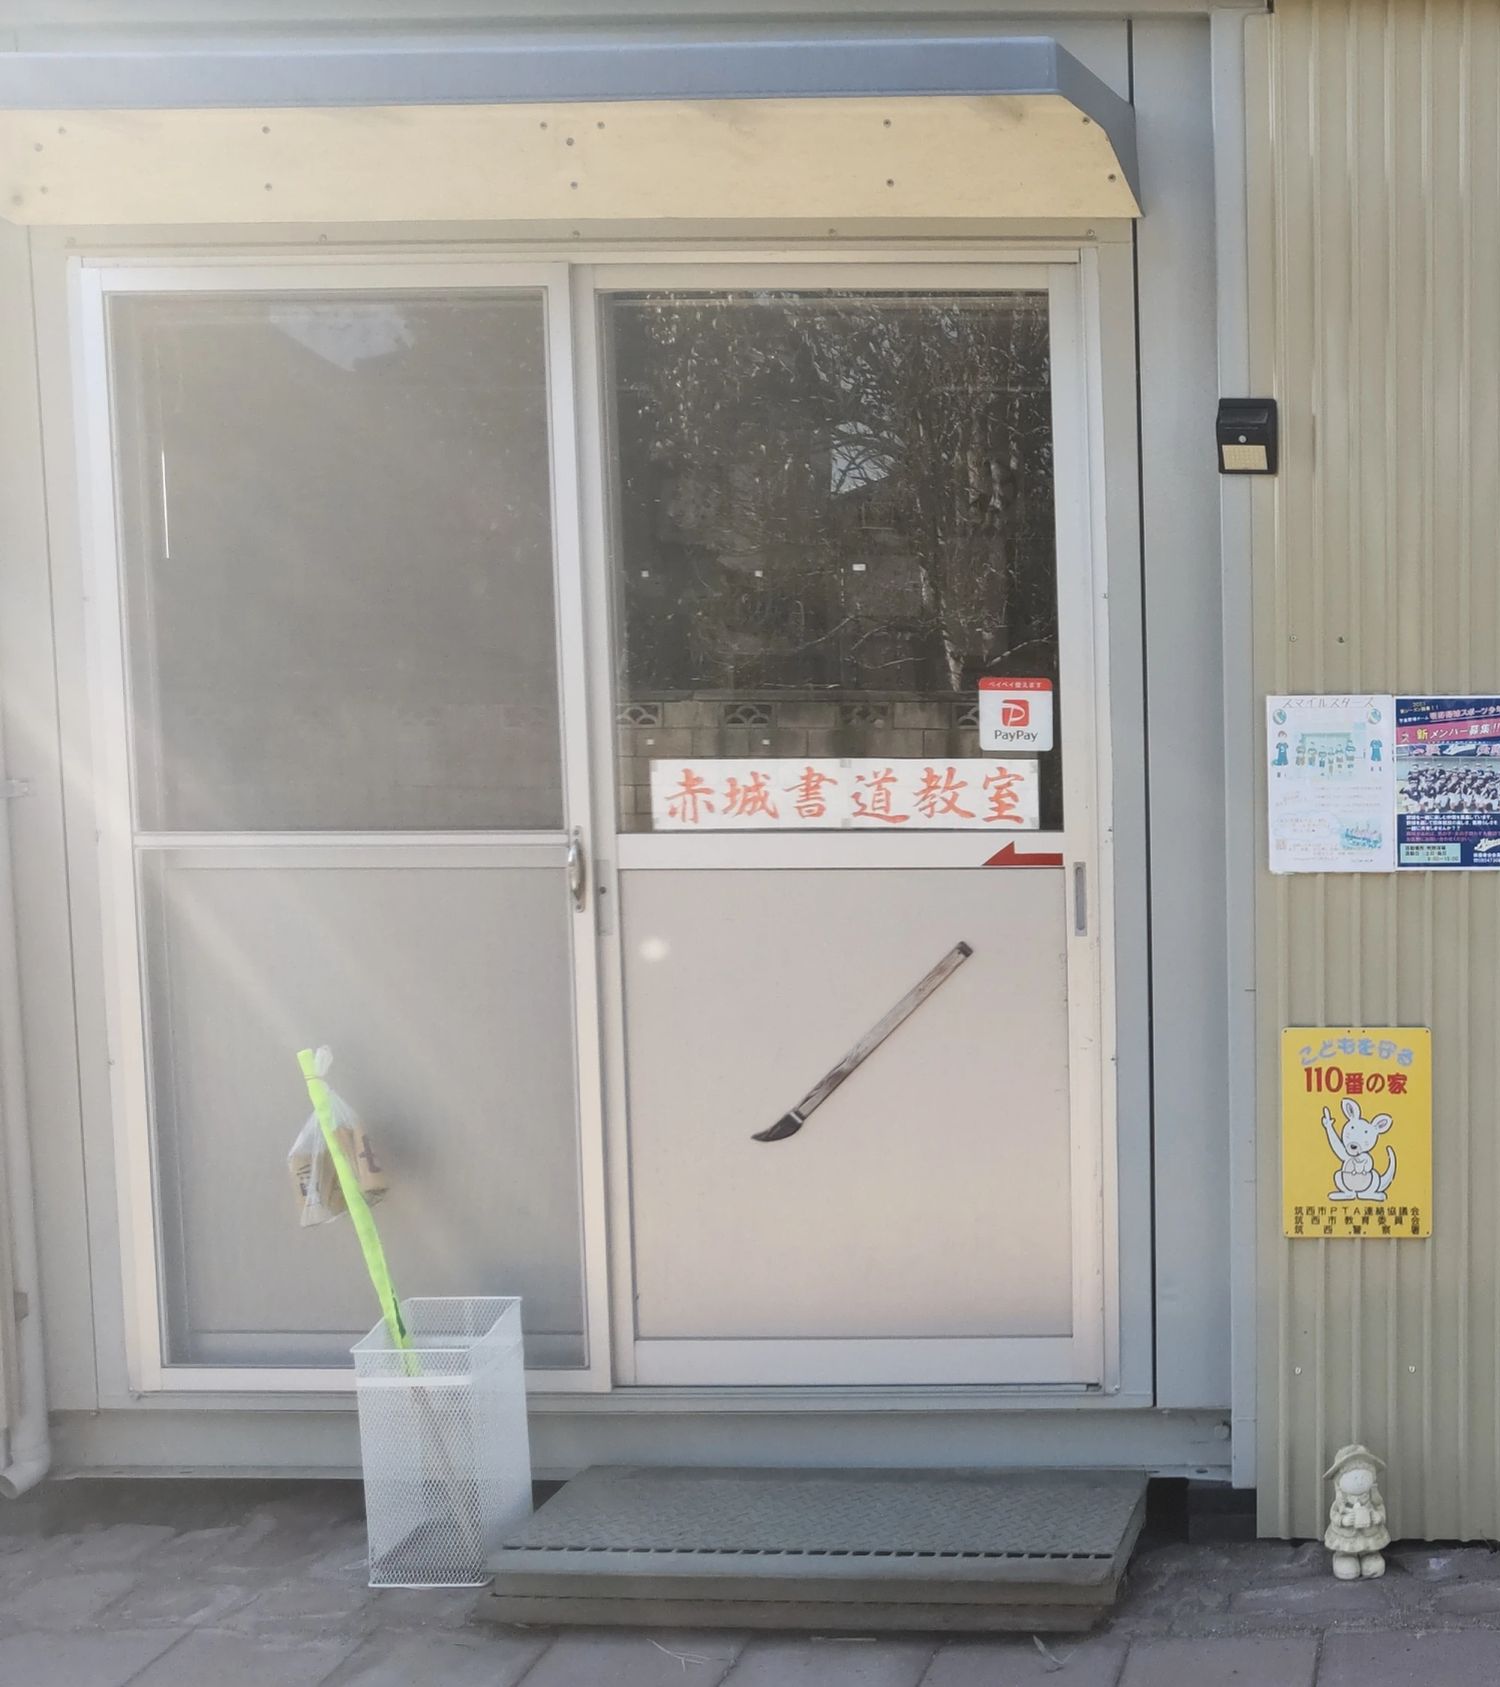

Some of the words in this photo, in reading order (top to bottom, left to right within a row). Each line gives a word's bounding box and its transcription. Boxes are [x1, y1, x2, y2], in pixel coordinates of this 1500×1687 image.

[994, 729, 1038, 742] PayPay
[665, 766, 1026, 824] 赤城書道教室
[1304, 1066, 1408, 1094] 110番の家
